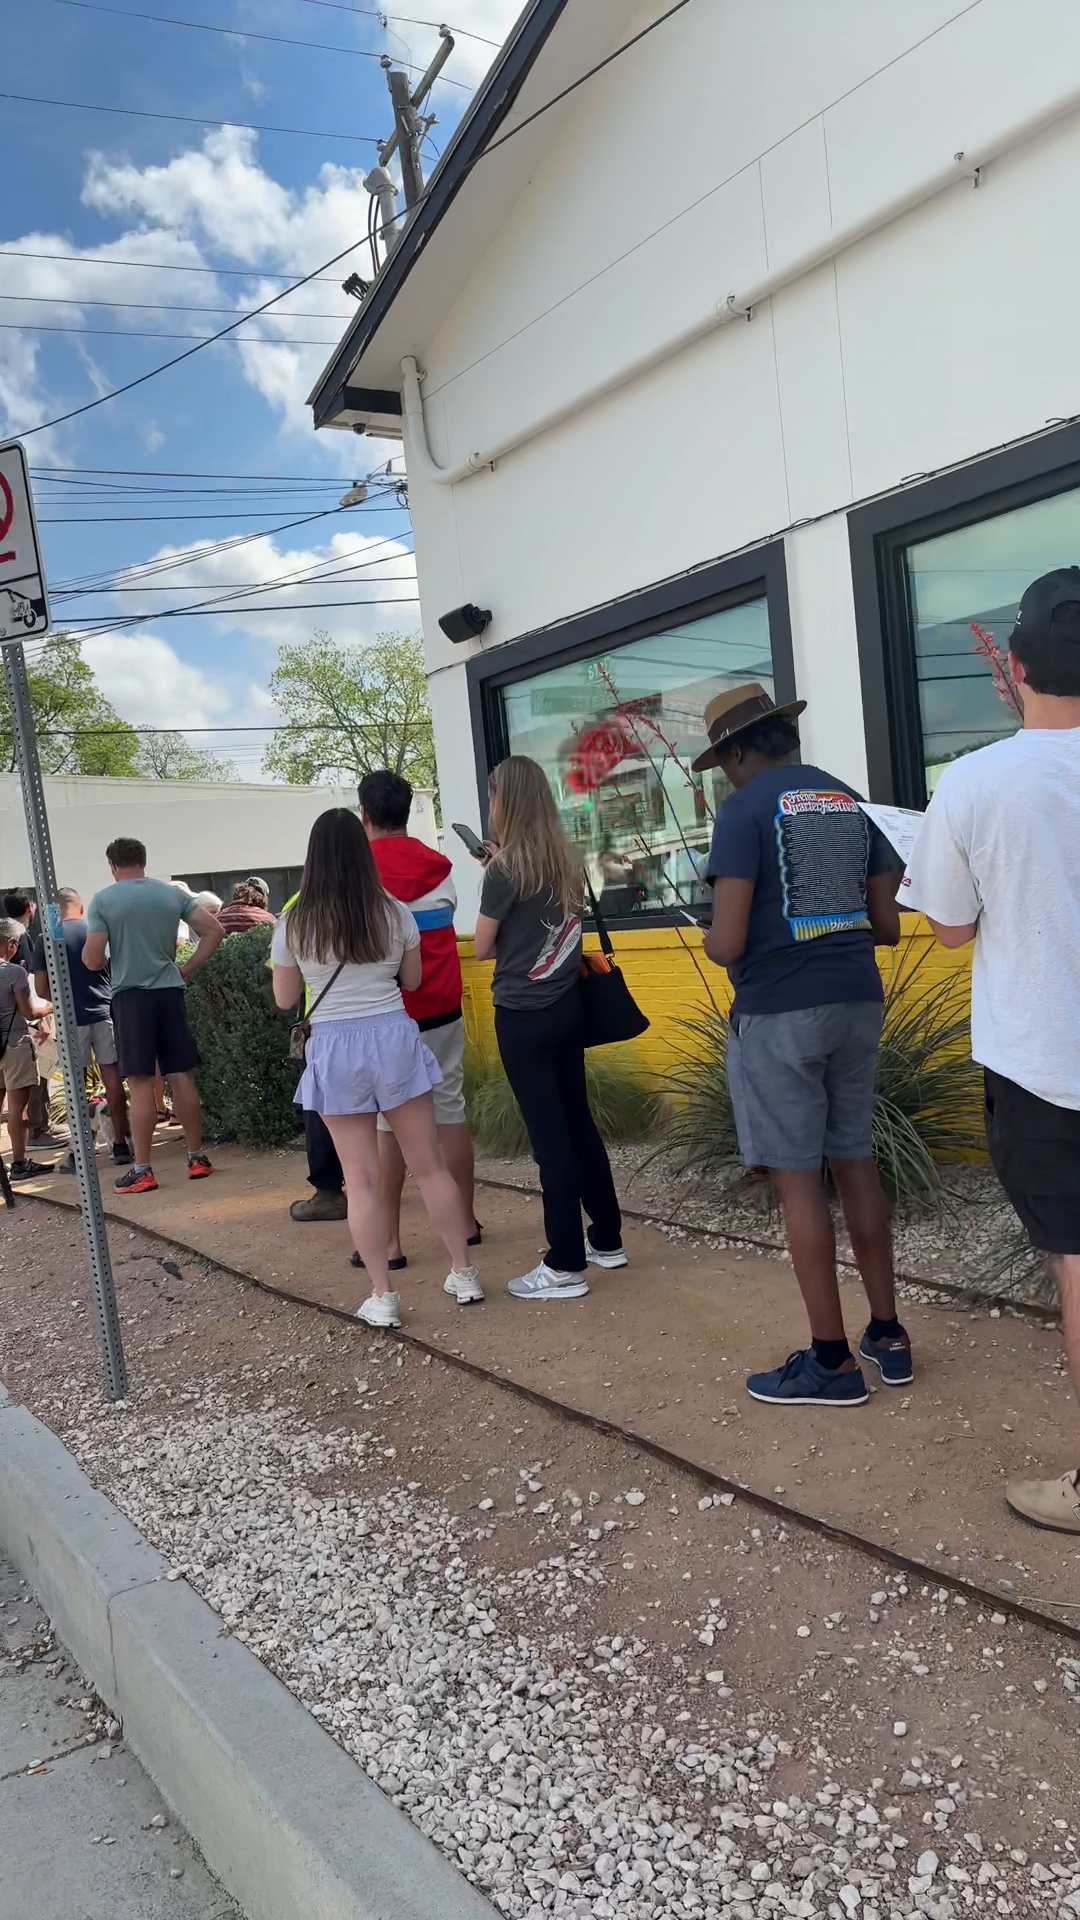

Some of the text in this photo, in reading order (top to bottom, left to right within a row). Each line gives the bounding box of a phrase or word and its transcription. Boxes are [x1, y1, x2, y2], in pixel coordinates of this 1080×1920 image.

[787, 790, 817, 804] French
[781, 797, 859, 815] Quarter Festival
[830, 920, 854, 932] 2025
